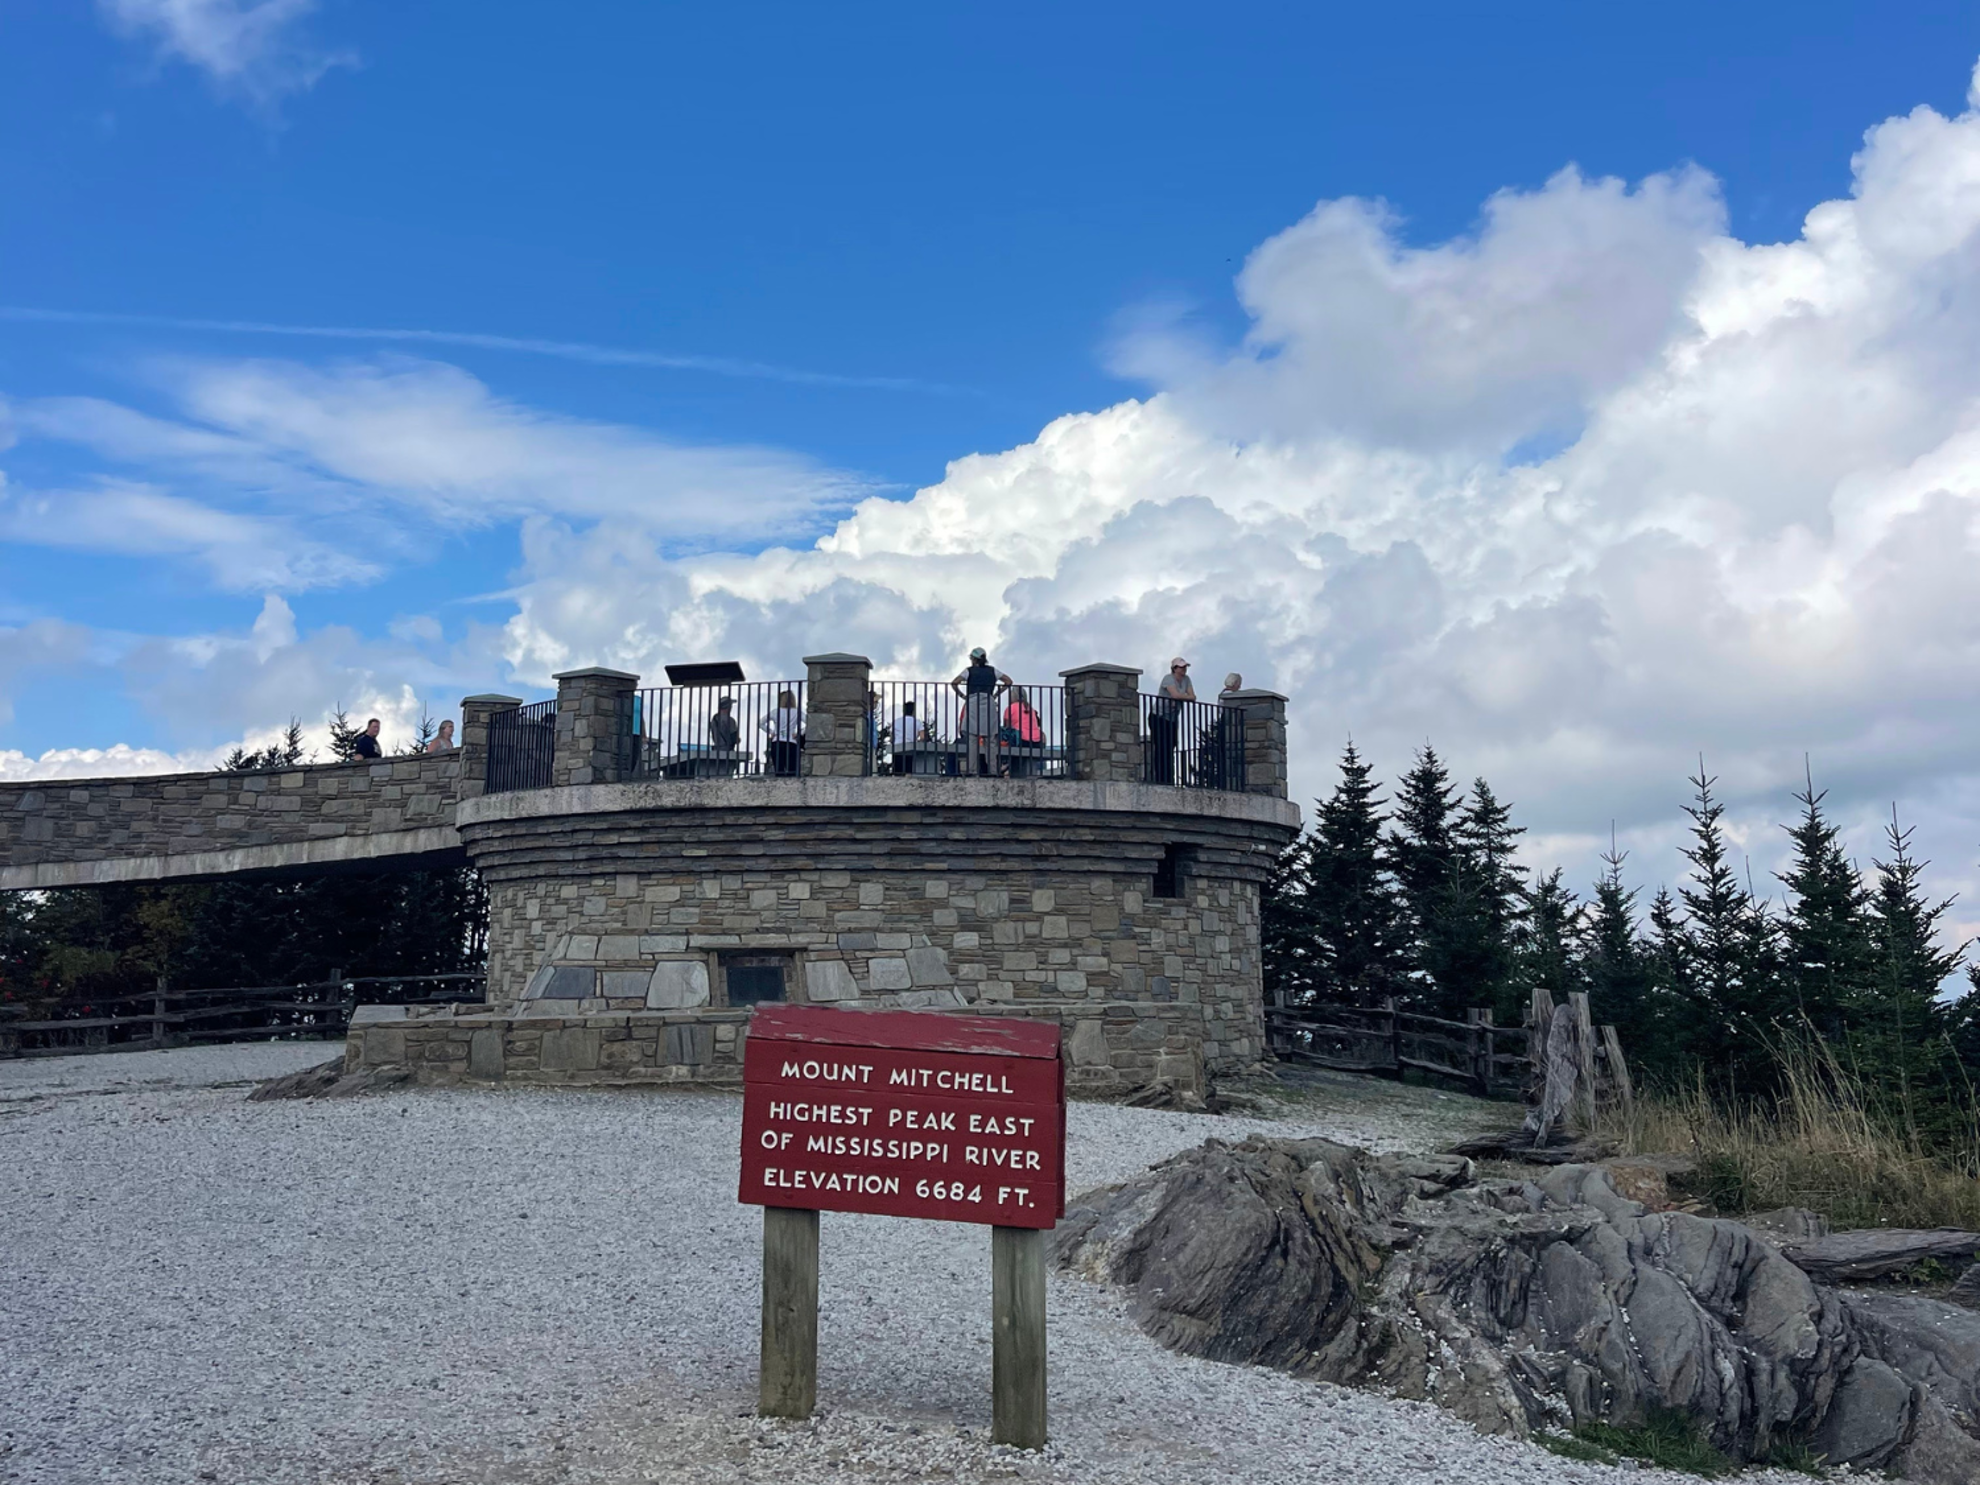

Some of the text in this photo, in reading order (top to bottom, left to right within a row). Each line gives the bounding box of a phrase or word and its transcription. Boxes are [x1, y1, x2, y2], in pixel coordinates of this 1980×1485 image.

[781, 1061, 1014, 1094] MOUNT MITCHELL
[770, 1102, 1035, 1137] HIGHEST PEAK EAST
[761, 1130, 1041, 1171] OF MISSISSIPPI RIVER
[764, 1168, 1035, 1208] ELEVATION 6684 FT.
